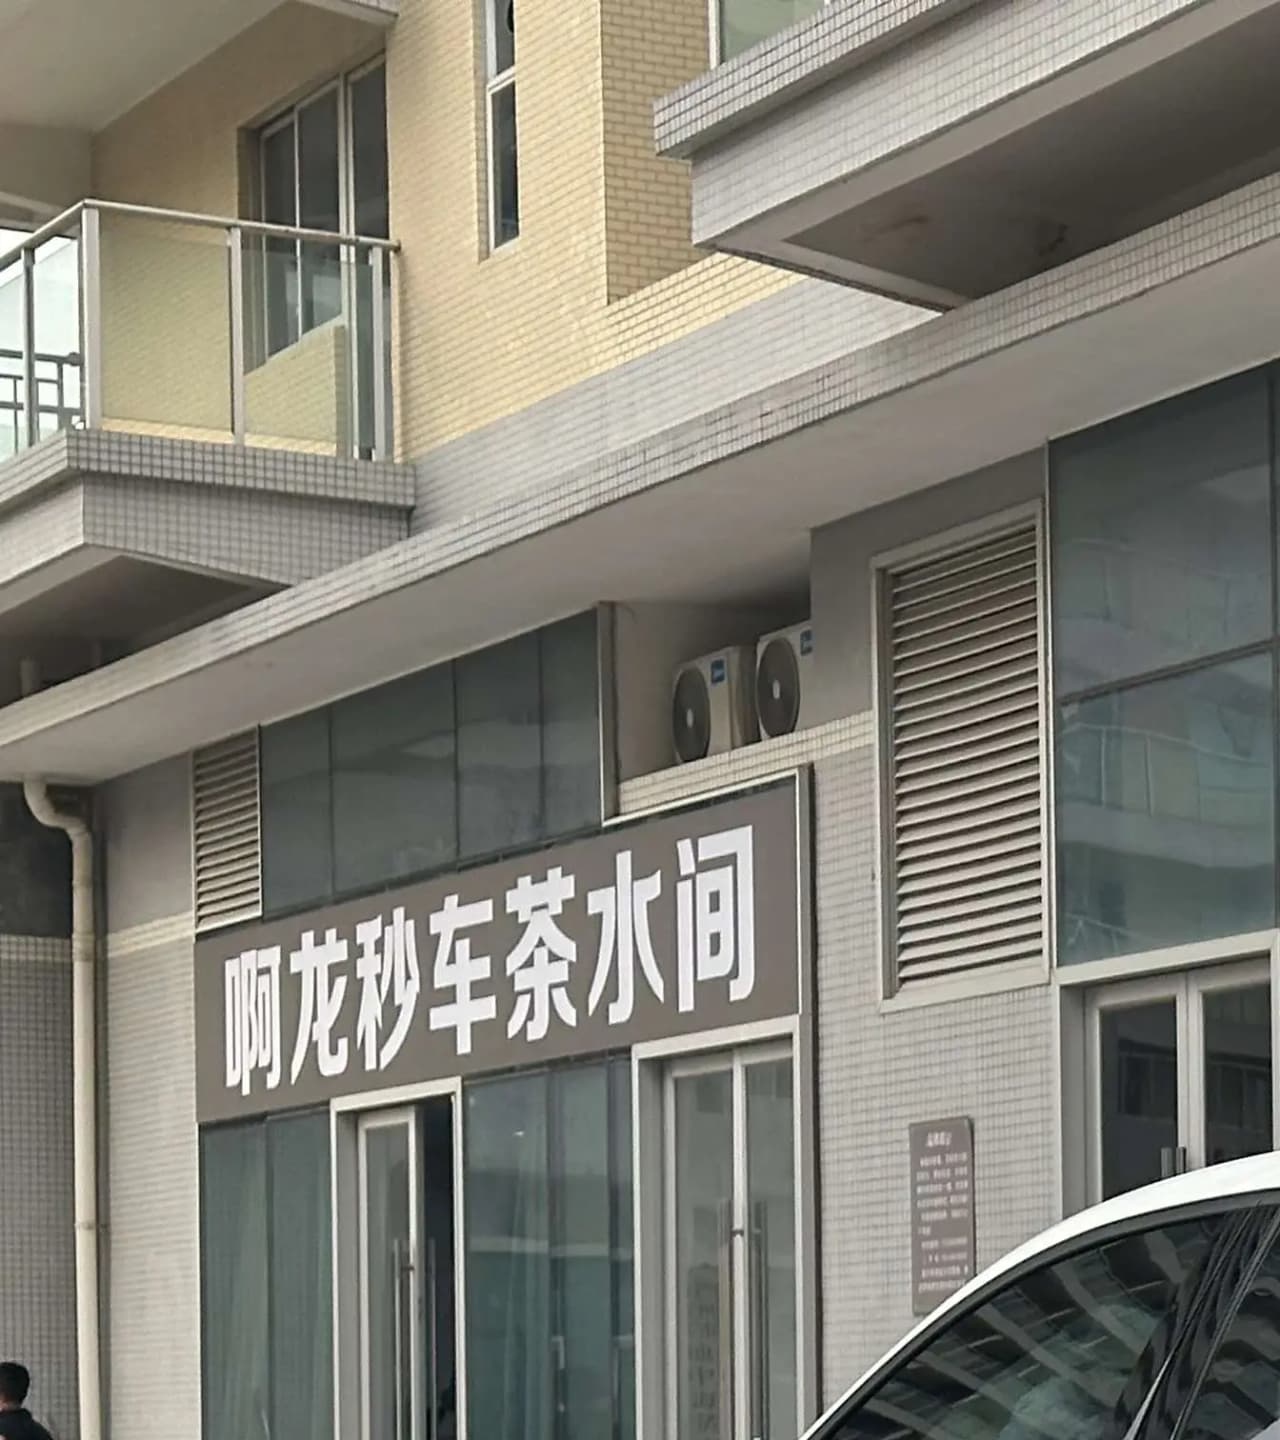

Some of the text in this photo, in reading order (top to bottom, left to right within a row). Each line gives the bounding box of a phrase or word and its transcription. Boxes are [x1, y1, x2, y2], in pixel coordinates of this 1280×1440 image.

[225, 825, 755, 1096] 啊龙秒车茶水间
